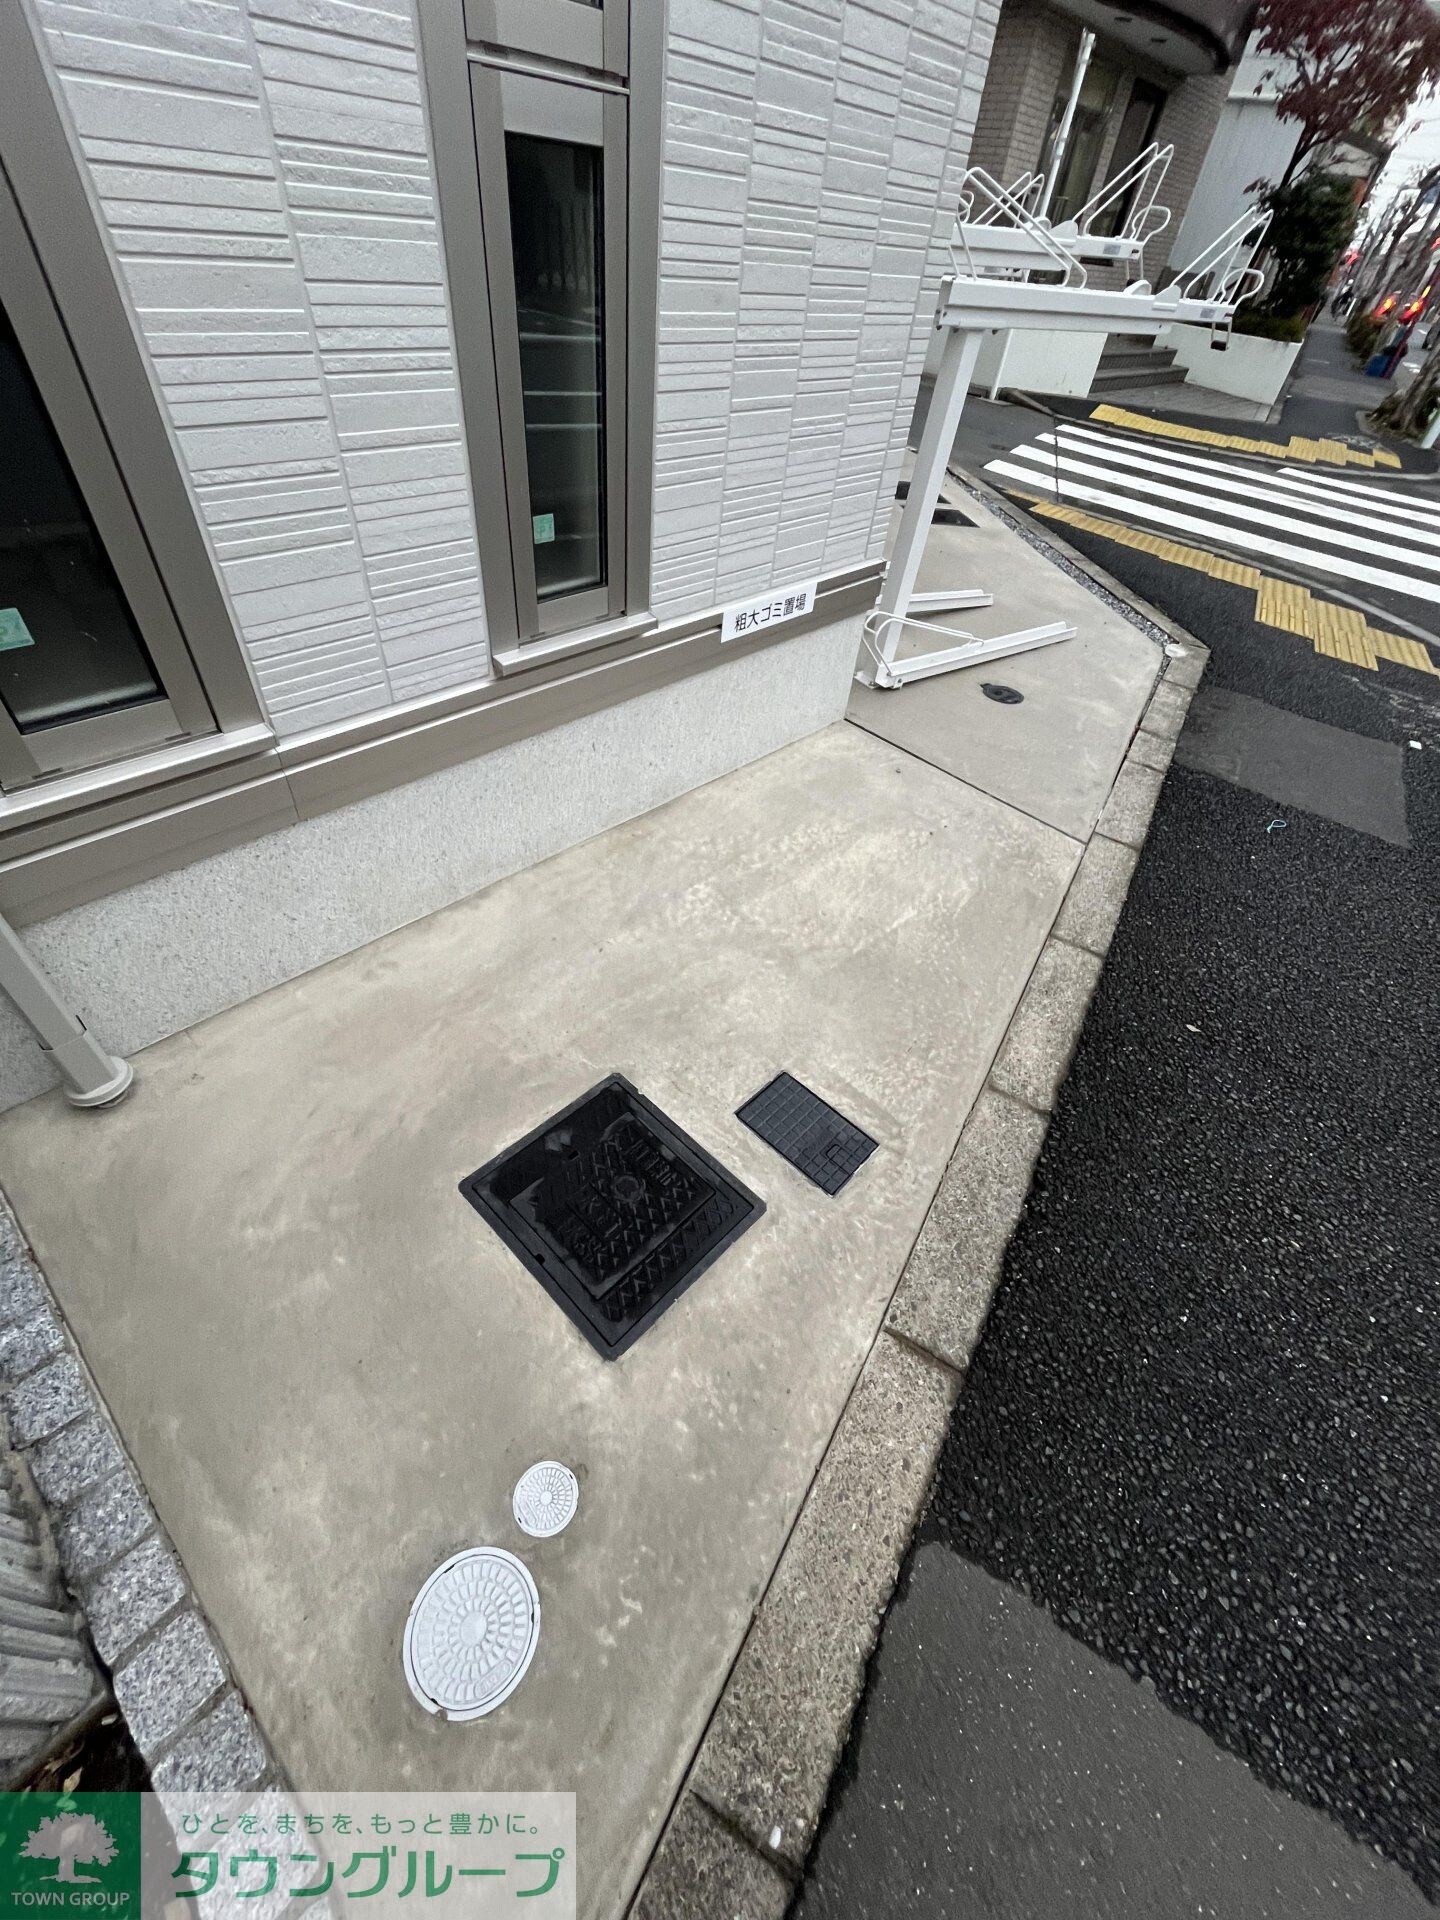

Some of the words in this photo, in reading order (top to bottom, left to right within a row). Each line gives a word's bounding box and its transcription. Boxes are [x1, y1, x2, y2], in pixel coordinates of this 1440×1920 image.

[735, 593, 806, 632] 粗大ゴミ置場
